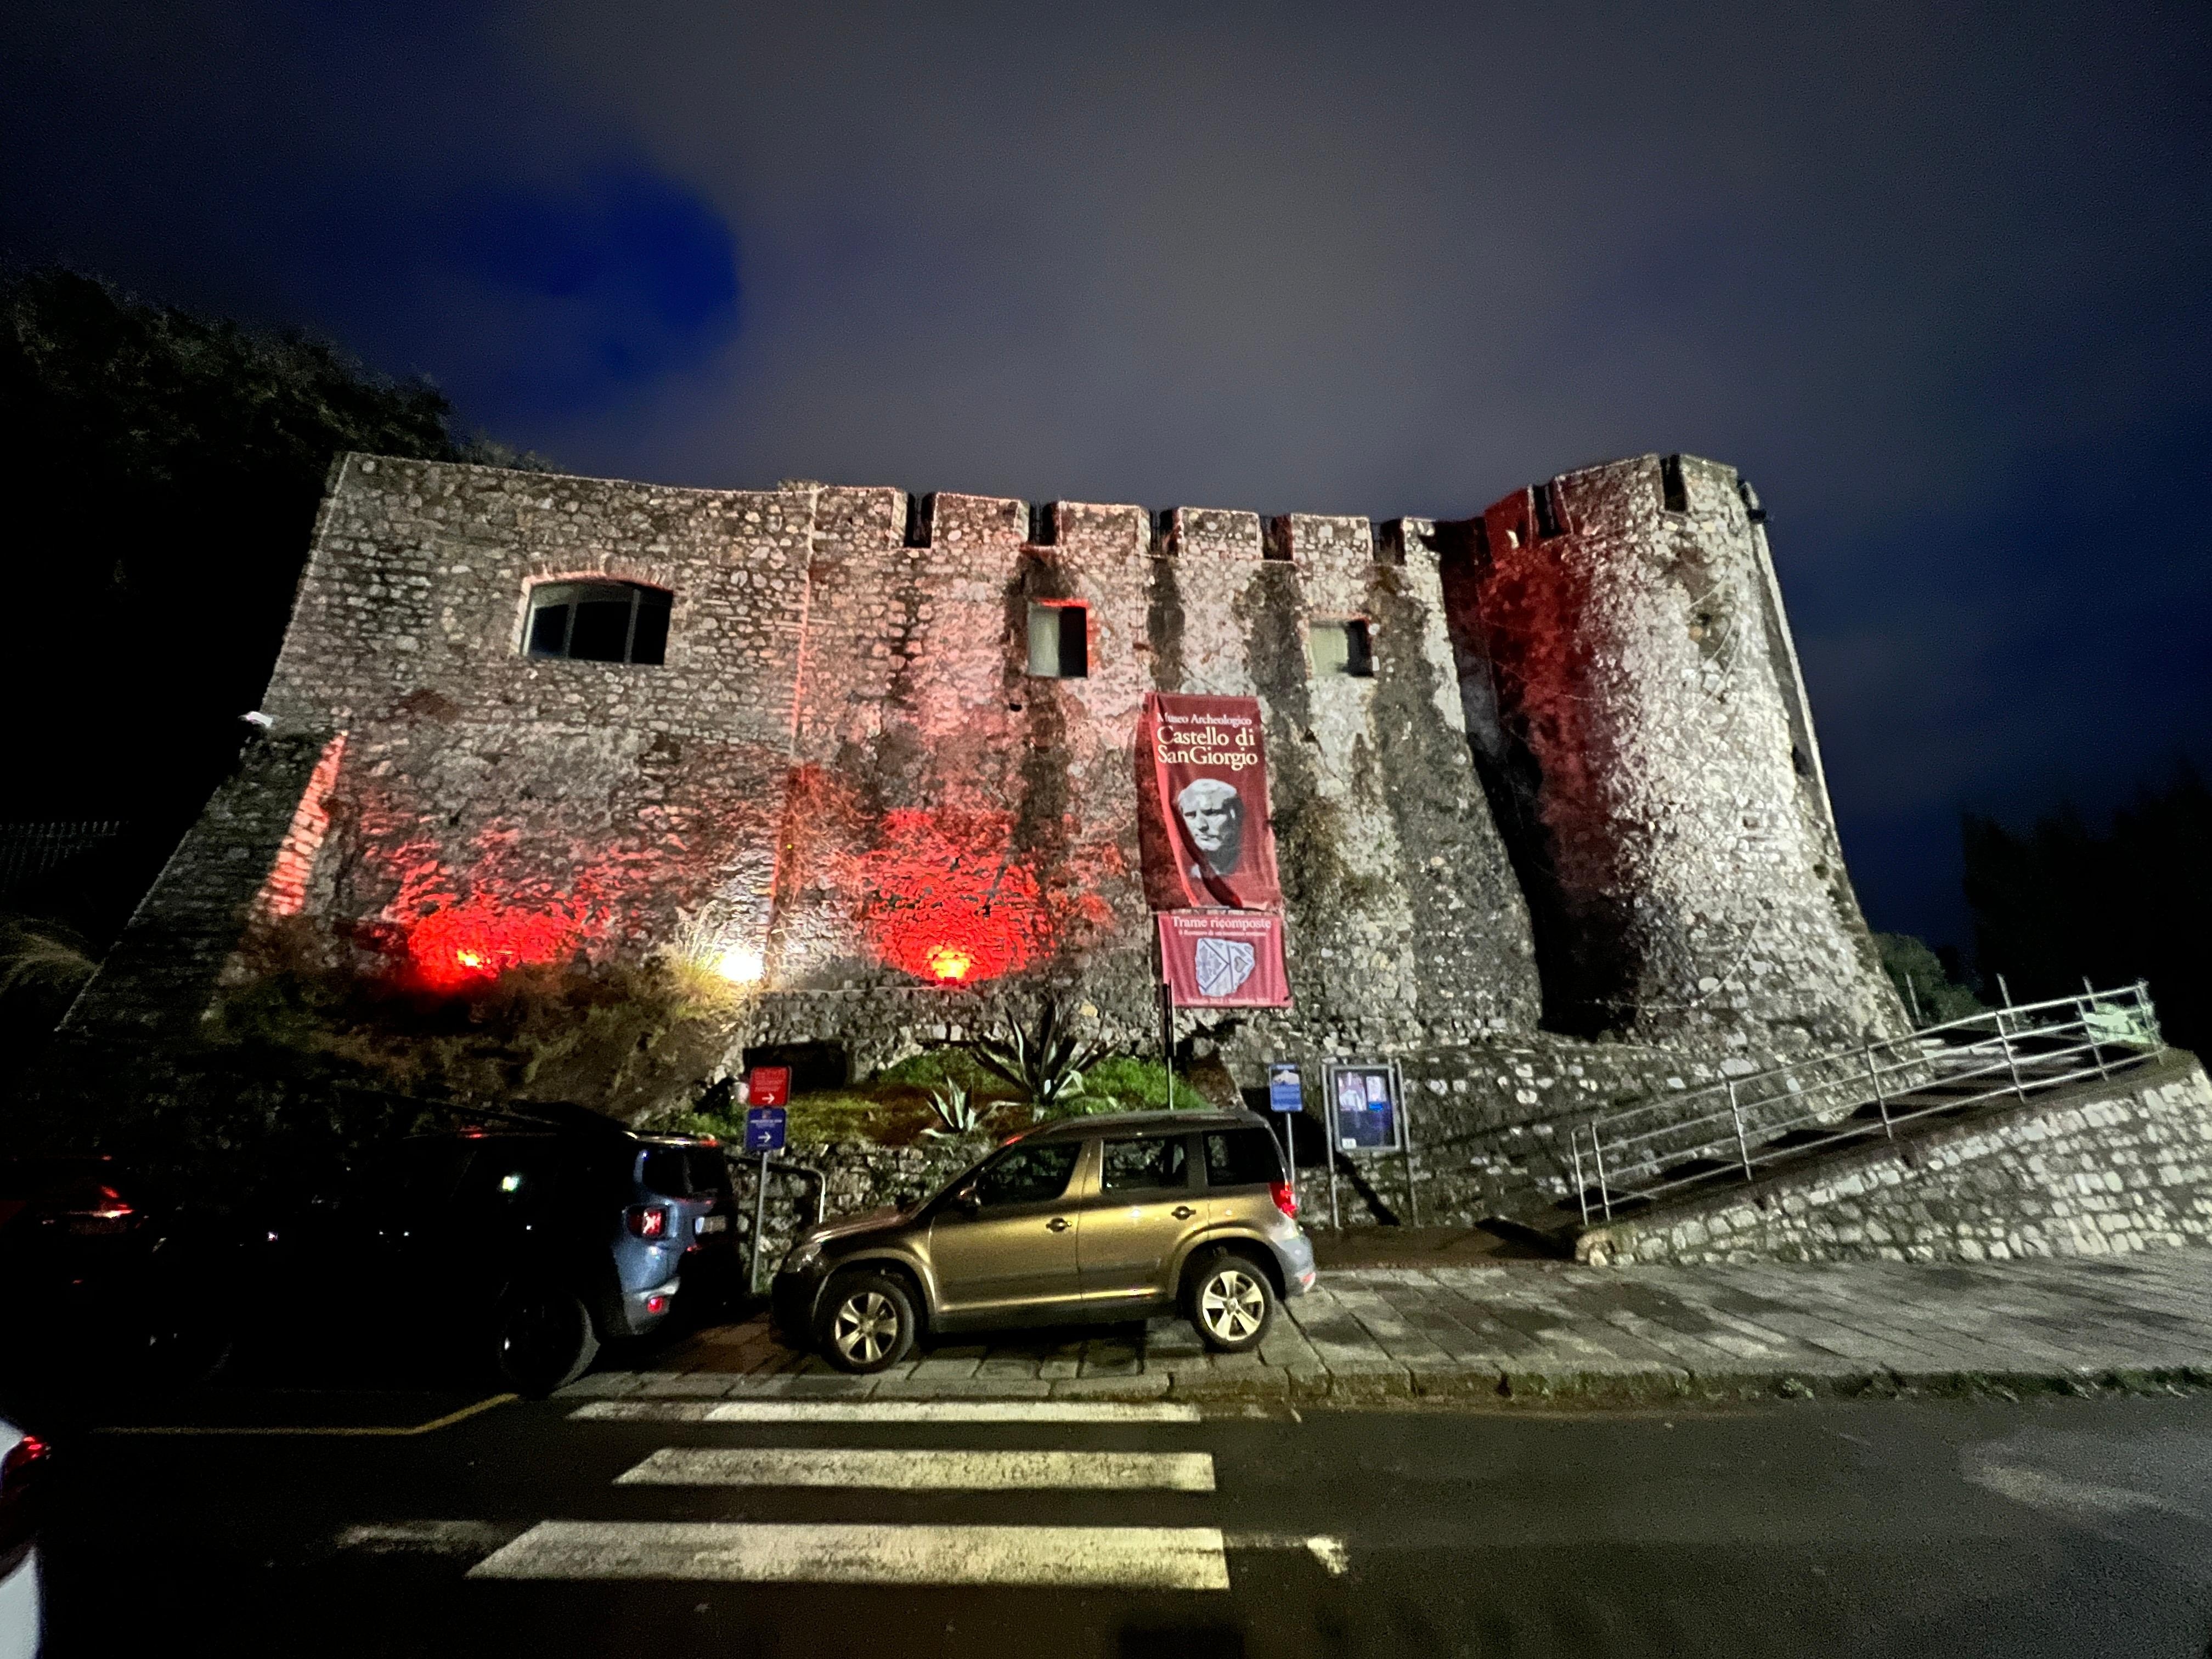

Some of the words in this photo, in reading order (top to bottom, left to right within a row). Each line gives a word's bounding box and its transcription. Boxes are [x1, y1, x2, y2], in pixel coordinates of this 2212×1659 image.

[1157, 713, 1189, 724] Museo
[1190, 714, 1252, 728] Archeologico
[1157, 726, 1229, 746] Castello
[1235, 726, 1255, 746] di
[1172, 916, 1207, 928] Trame
[1210, 917, 1272, 931] ricomposte
